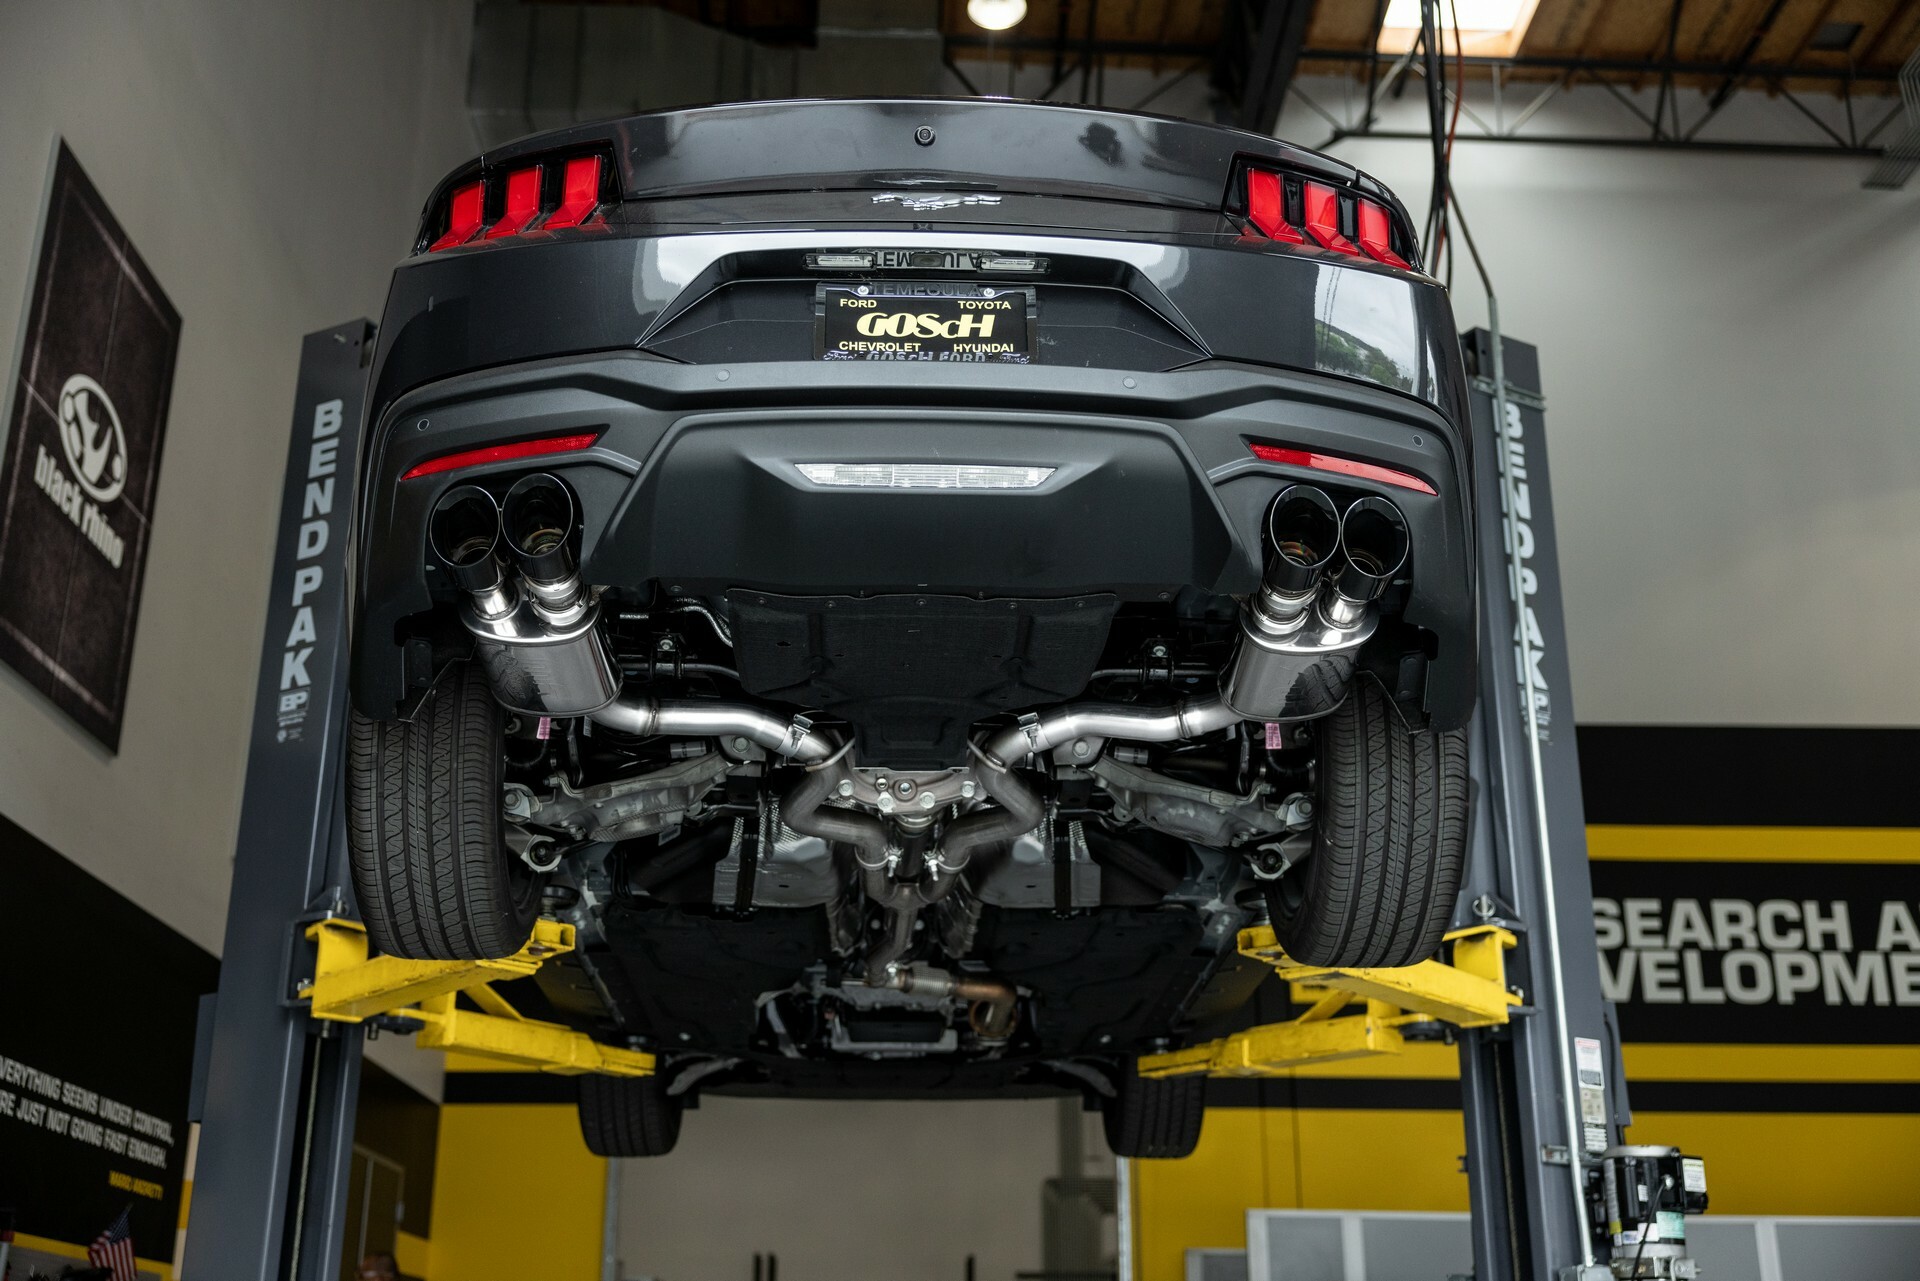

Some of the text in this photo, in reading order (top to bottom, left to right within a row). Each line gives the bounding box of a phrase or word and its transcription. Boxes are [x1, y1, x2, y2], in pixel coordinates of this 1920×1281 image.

[840, 298, 1011, 310] FORD TOYOTA
[871, 283, 982, 297] TEMECULA
[839, 341, 1014, 353] CHEVROLET HYUNDAI
[33, 443, 125, 569] black rhino
[280, 398, 344, 691] BENDPAK
[1491, 397, 1549, 690] BENDPAK
[1592, 897, 1920, 952] SEARCH A
[1596, 948, 1920, 1007] VELOPME
[0, 1054, 62, 1101] VERYTHING
[62, 1081, 99, 1115] SEEMS
[98, 1095, 133, 1129] UNDER
[16, 1097, 47, 1127] JUST
[46, 1107, 71, 1136] NOT
[70, 1116, 104, 1147] GOING
[103, 1127, 129, 1156] FAST
